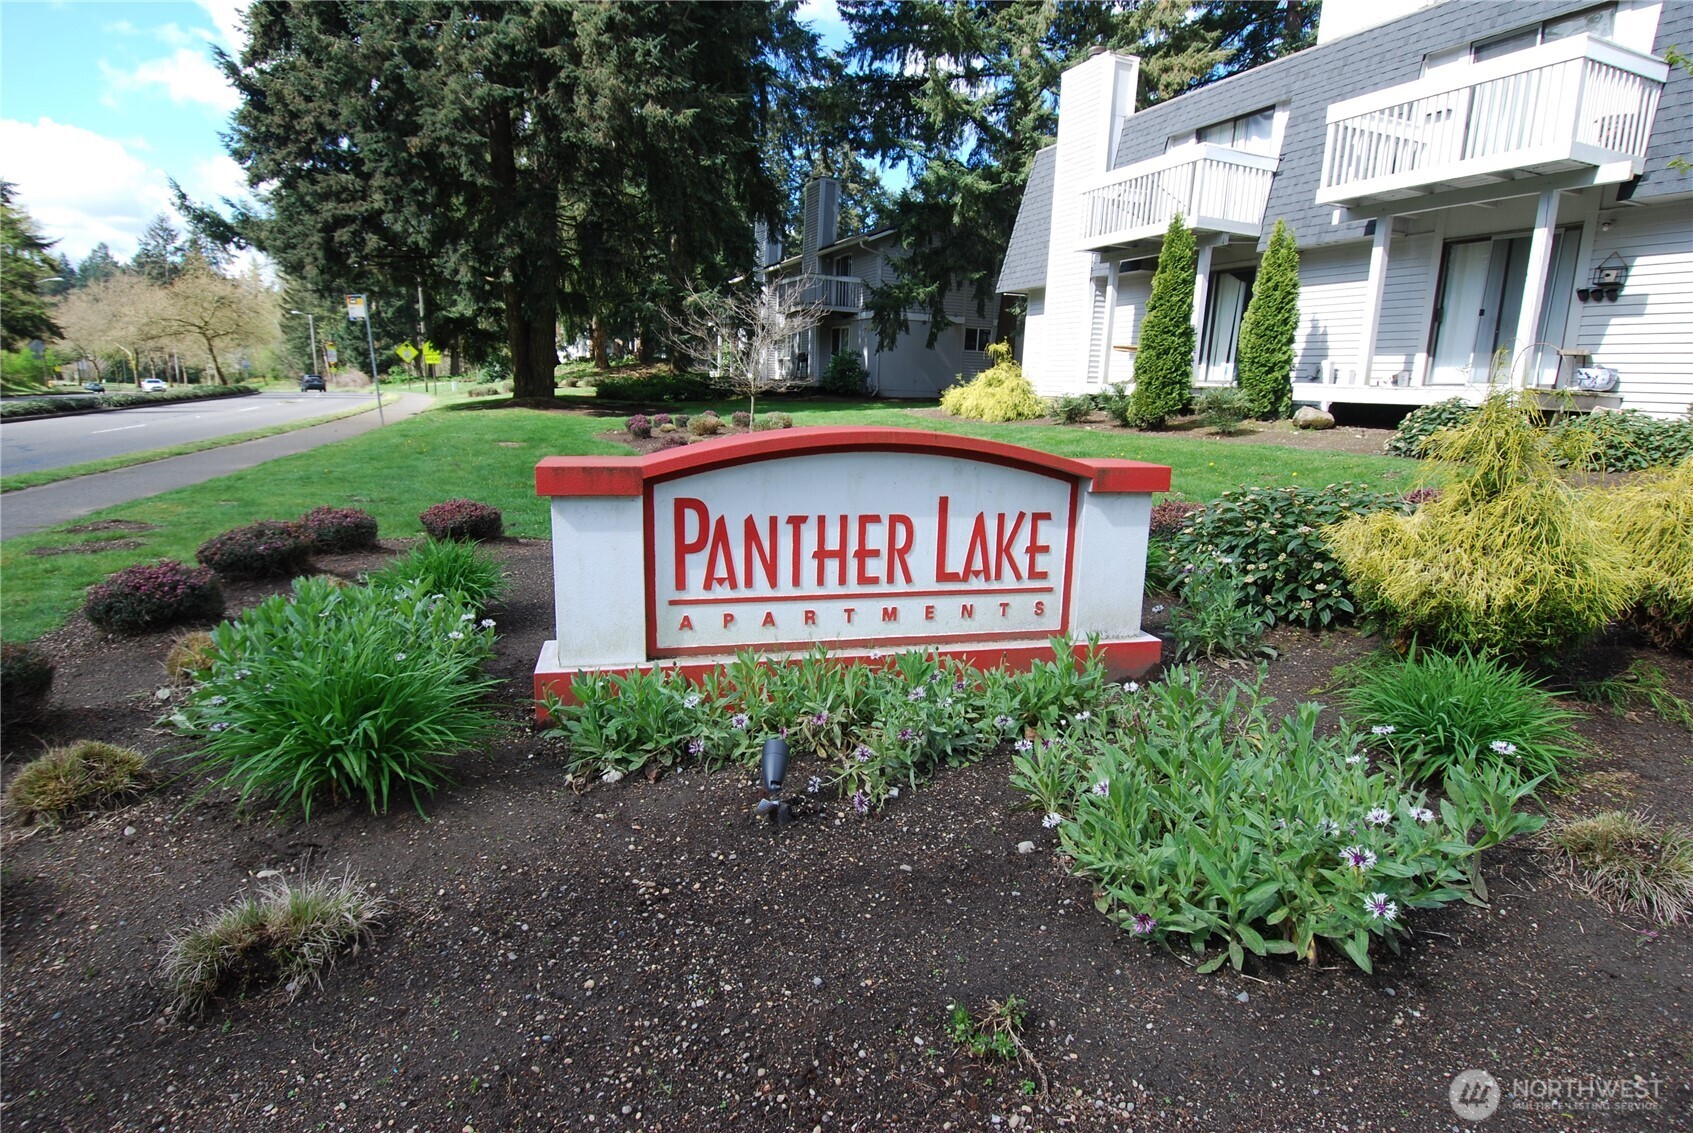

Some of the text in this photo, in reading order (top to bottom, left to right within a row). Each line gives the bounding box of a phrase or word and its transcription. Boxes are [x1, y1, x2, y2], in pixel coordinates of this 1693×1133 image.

[674, 496, 1052, 591] PANTHER LAKE
[678, 601, 1045, 631] APARTMENTS
